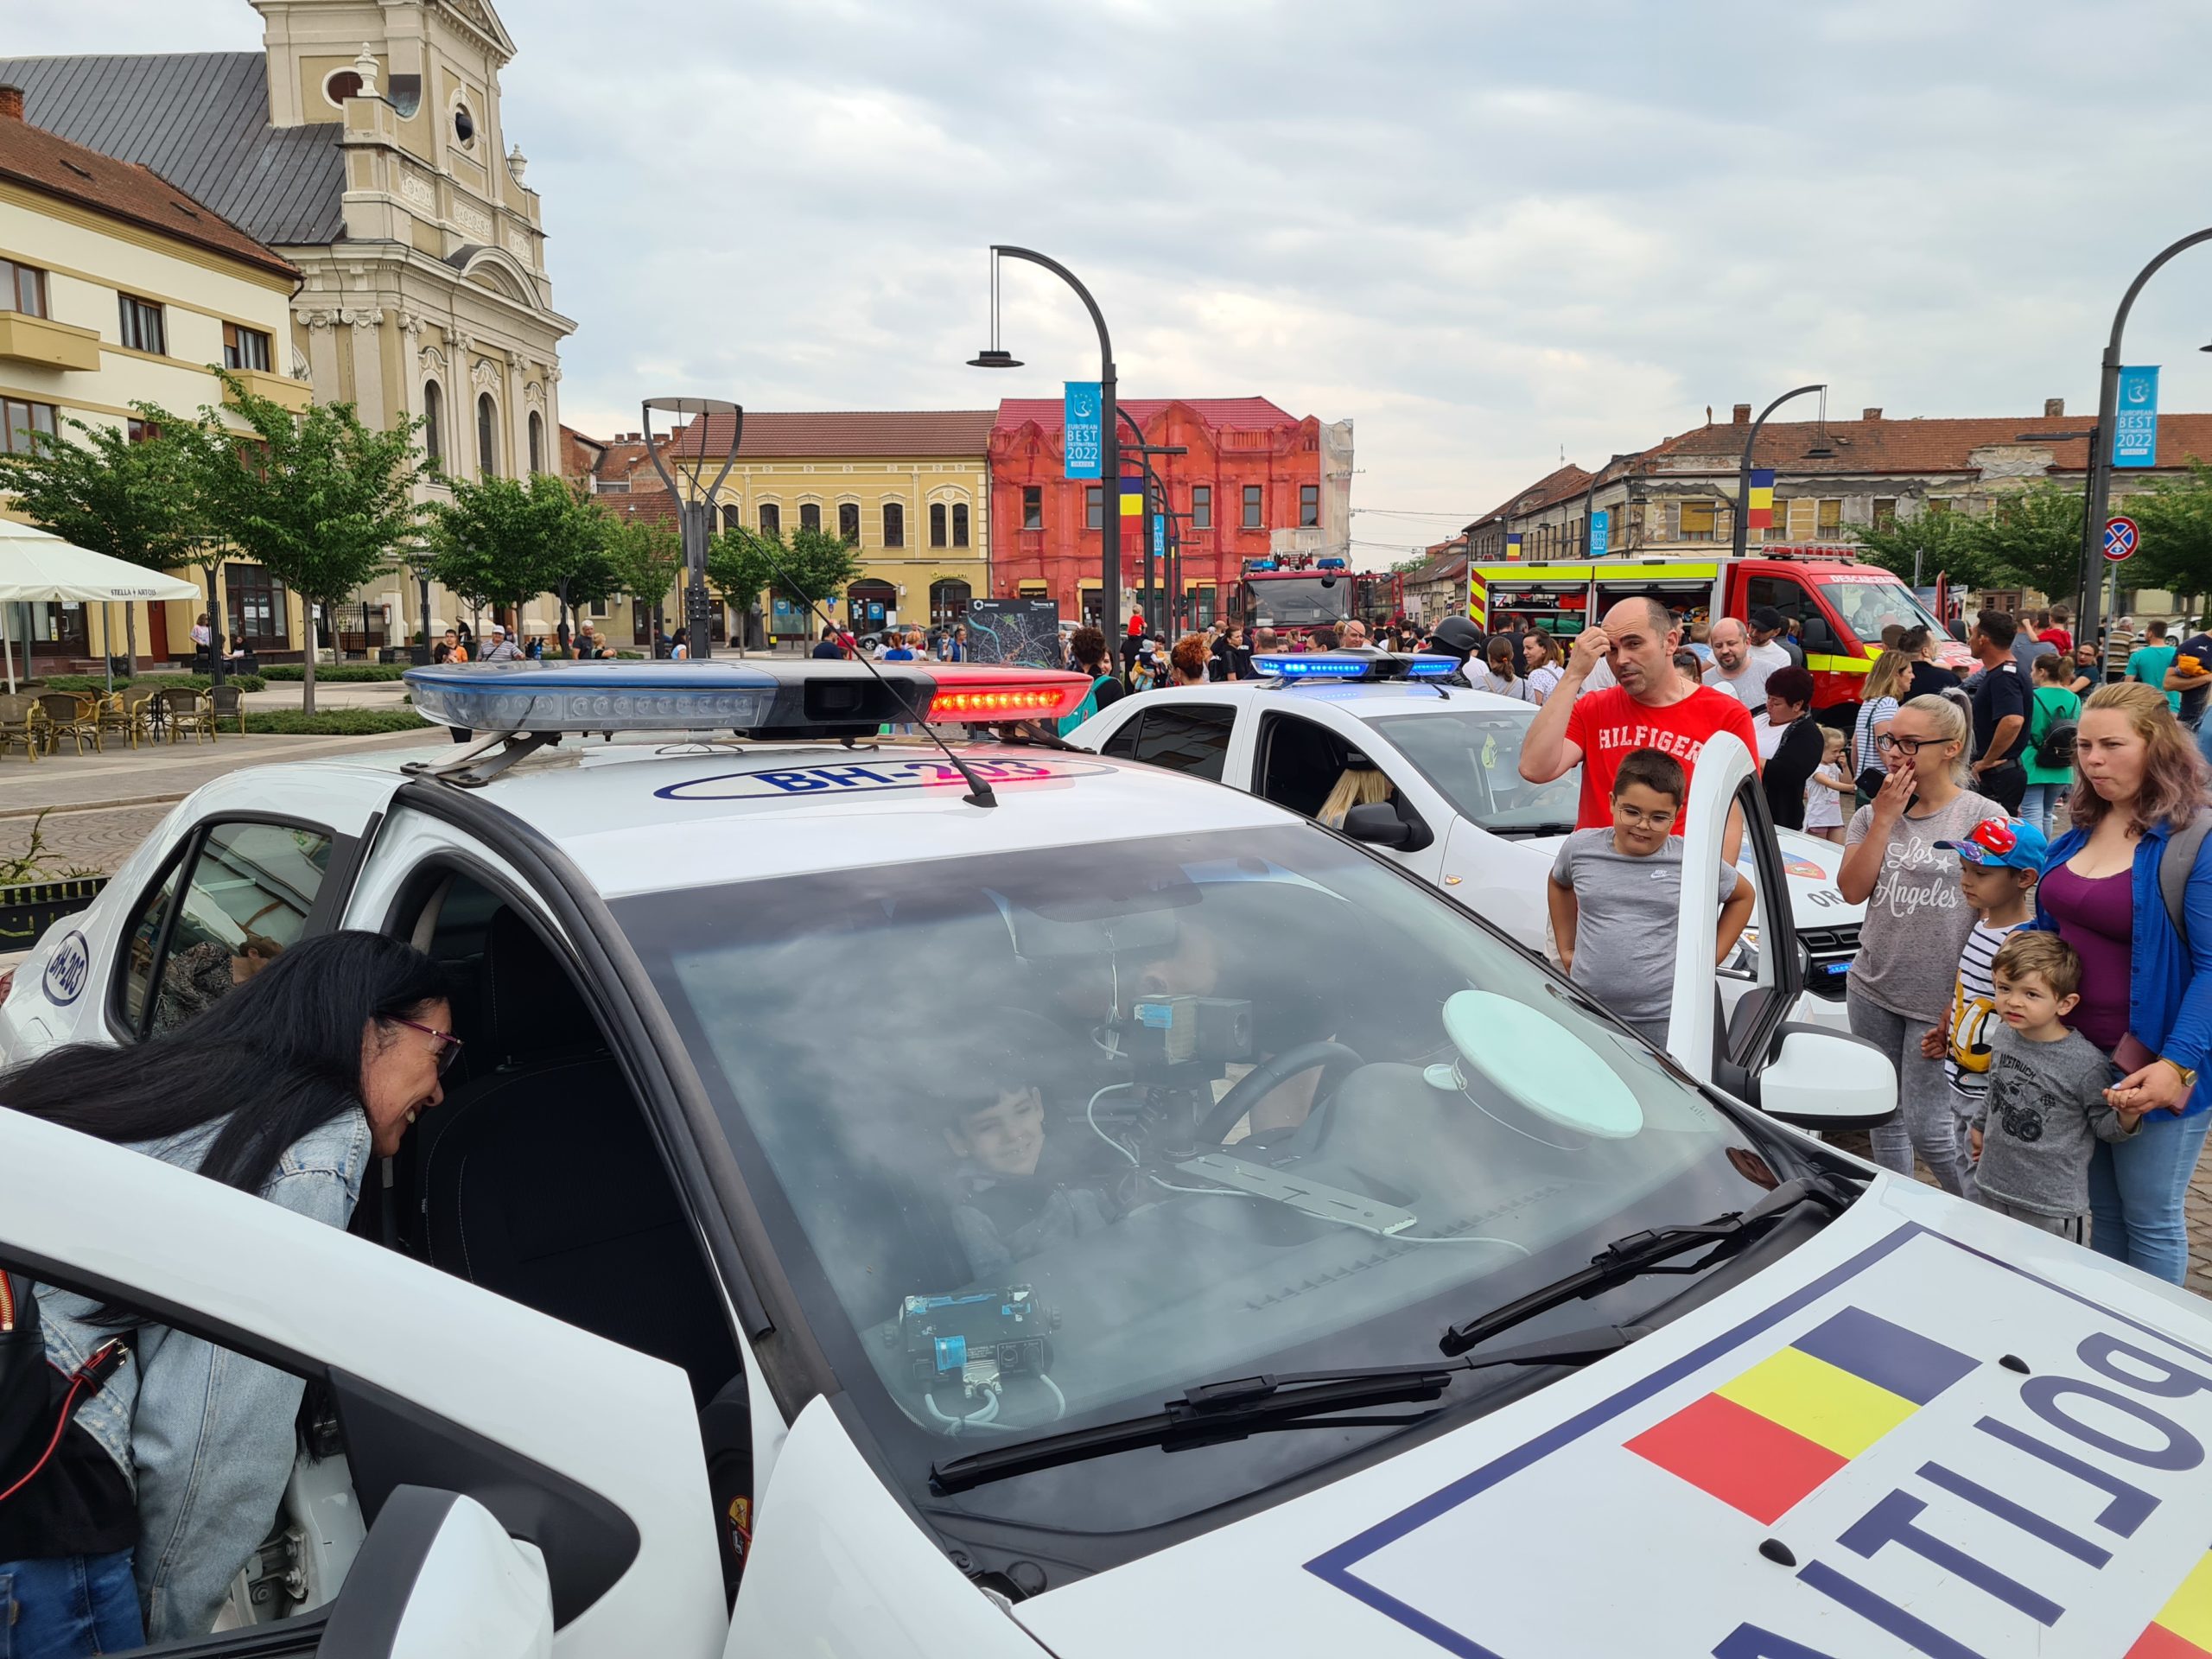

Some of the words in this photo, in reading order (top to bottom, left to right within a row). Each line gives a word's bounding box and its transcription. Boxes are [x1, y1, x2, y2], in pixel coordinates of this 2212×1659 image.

[1067, 430, 1097, 442] BEST
[2120, 416, 2152, 428] BEST
[1067, 447, 1097, 460] 2022
[2117, 434, 2152, 447] 2022
[1599, 726, 1704, 764] HILFIGER
[752, 760, 1051, 792] BH-203
[1887, 836, 1936, 871] Los
[1871, 871, 1959, 918] Angeles
[48, 940, 85, 995] BH-203
